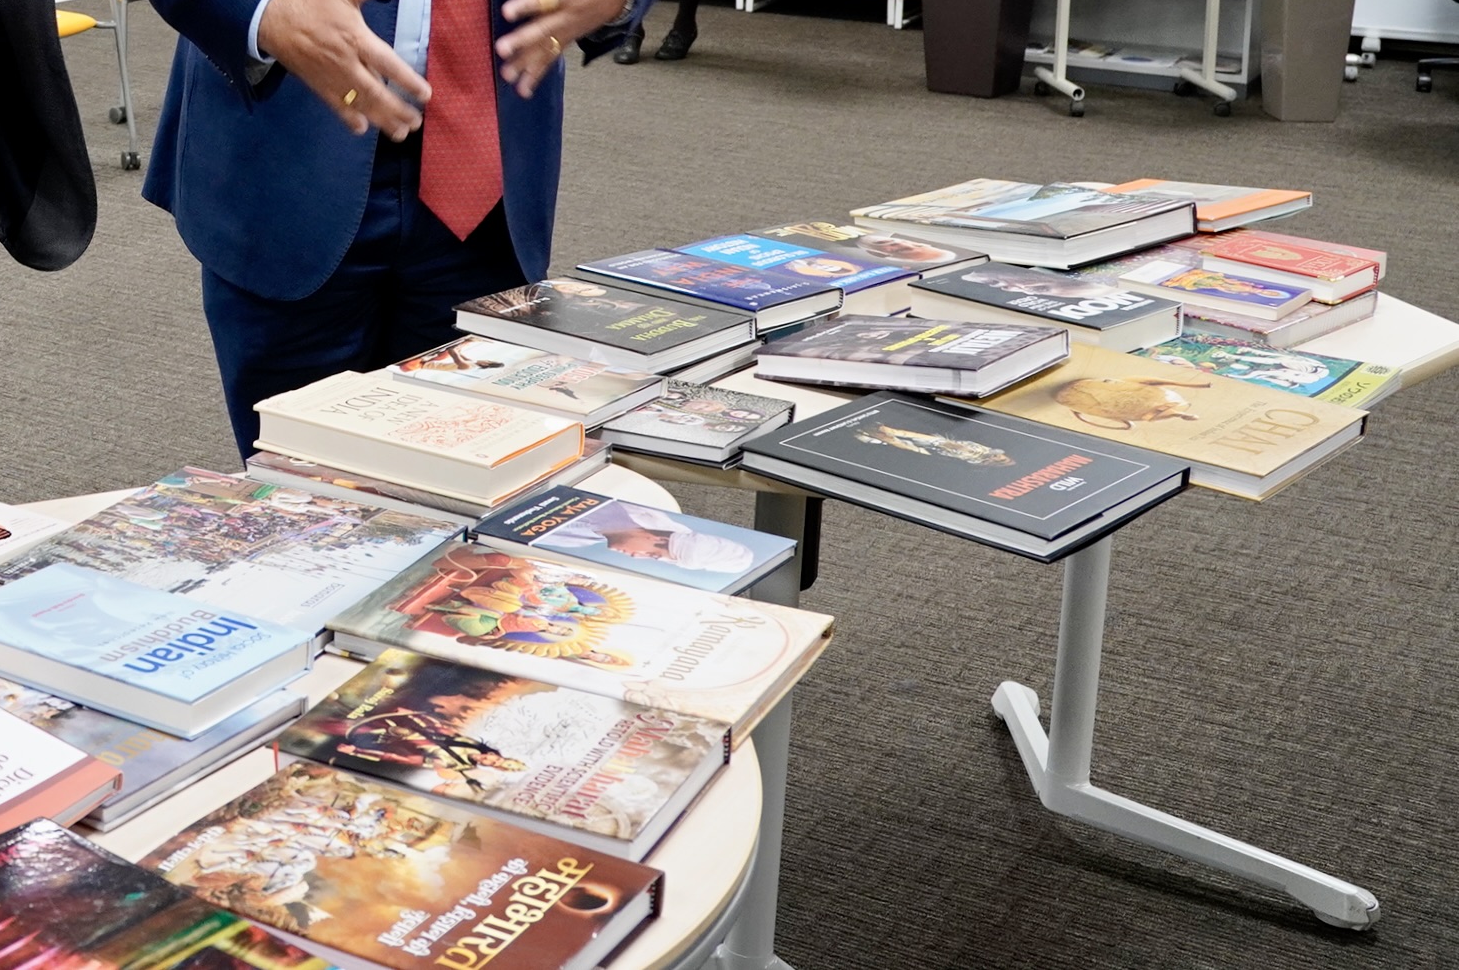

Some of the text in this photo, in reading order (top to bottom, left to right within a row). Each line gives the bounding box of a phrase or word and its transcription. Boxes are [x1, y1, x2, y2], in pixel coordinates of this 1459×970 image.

[1044, 289, 1148, 320] MODI
[318, 385, 402, 417] INDIA
[352, 409, 389, 422] OF
[374, 393, 425, 412] IDEA
[381, 406, 431, 425] NEW
[1212, 409, 1320, 454] CHAI
[985, 453, 1096, 501] MAHARASHTRA
[1045, 474, 1085, 491] WILD
[555, 496, 601, 516] RAJA
[516, 514, 569, 537] YOGA
[96, 608, 217, 664] Buddhism
[120, 616, 259, 675] Indian
[657, 614, 768, 682] Ramayana
[345, 686, 396, 720] Saroj Bala
[530, 717, 635, 812] RETOLD WITH SCIENTIFIC
[555, 713, 678, 823] Mahabharat
[510, 764, 562, 806] EVIDENCE
[433, 857, 595, 969] महाभारत
